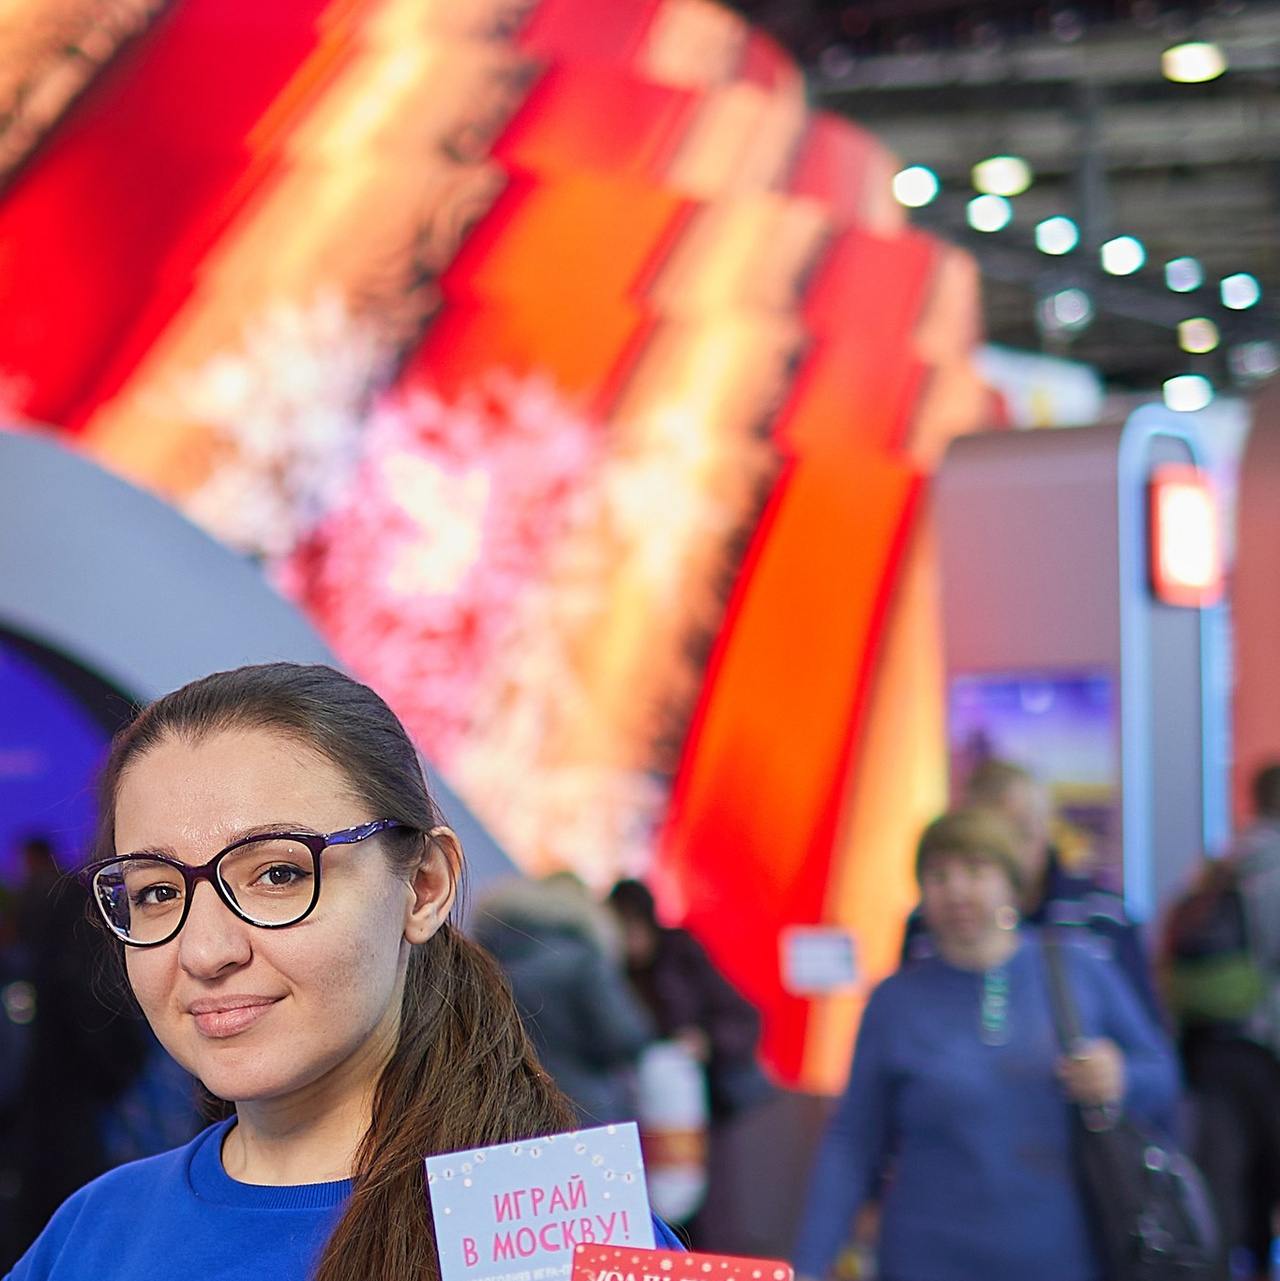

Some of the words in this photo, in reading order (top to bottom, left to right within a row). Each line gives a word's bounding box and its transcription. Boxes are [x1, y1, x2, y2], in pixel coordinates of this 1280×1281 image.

[493, 1174, 587, 1223] ИГРАЙ
[462, 1237, 479, 1267] В
[493, 1211, 629, 1262] МОСКВУ!
